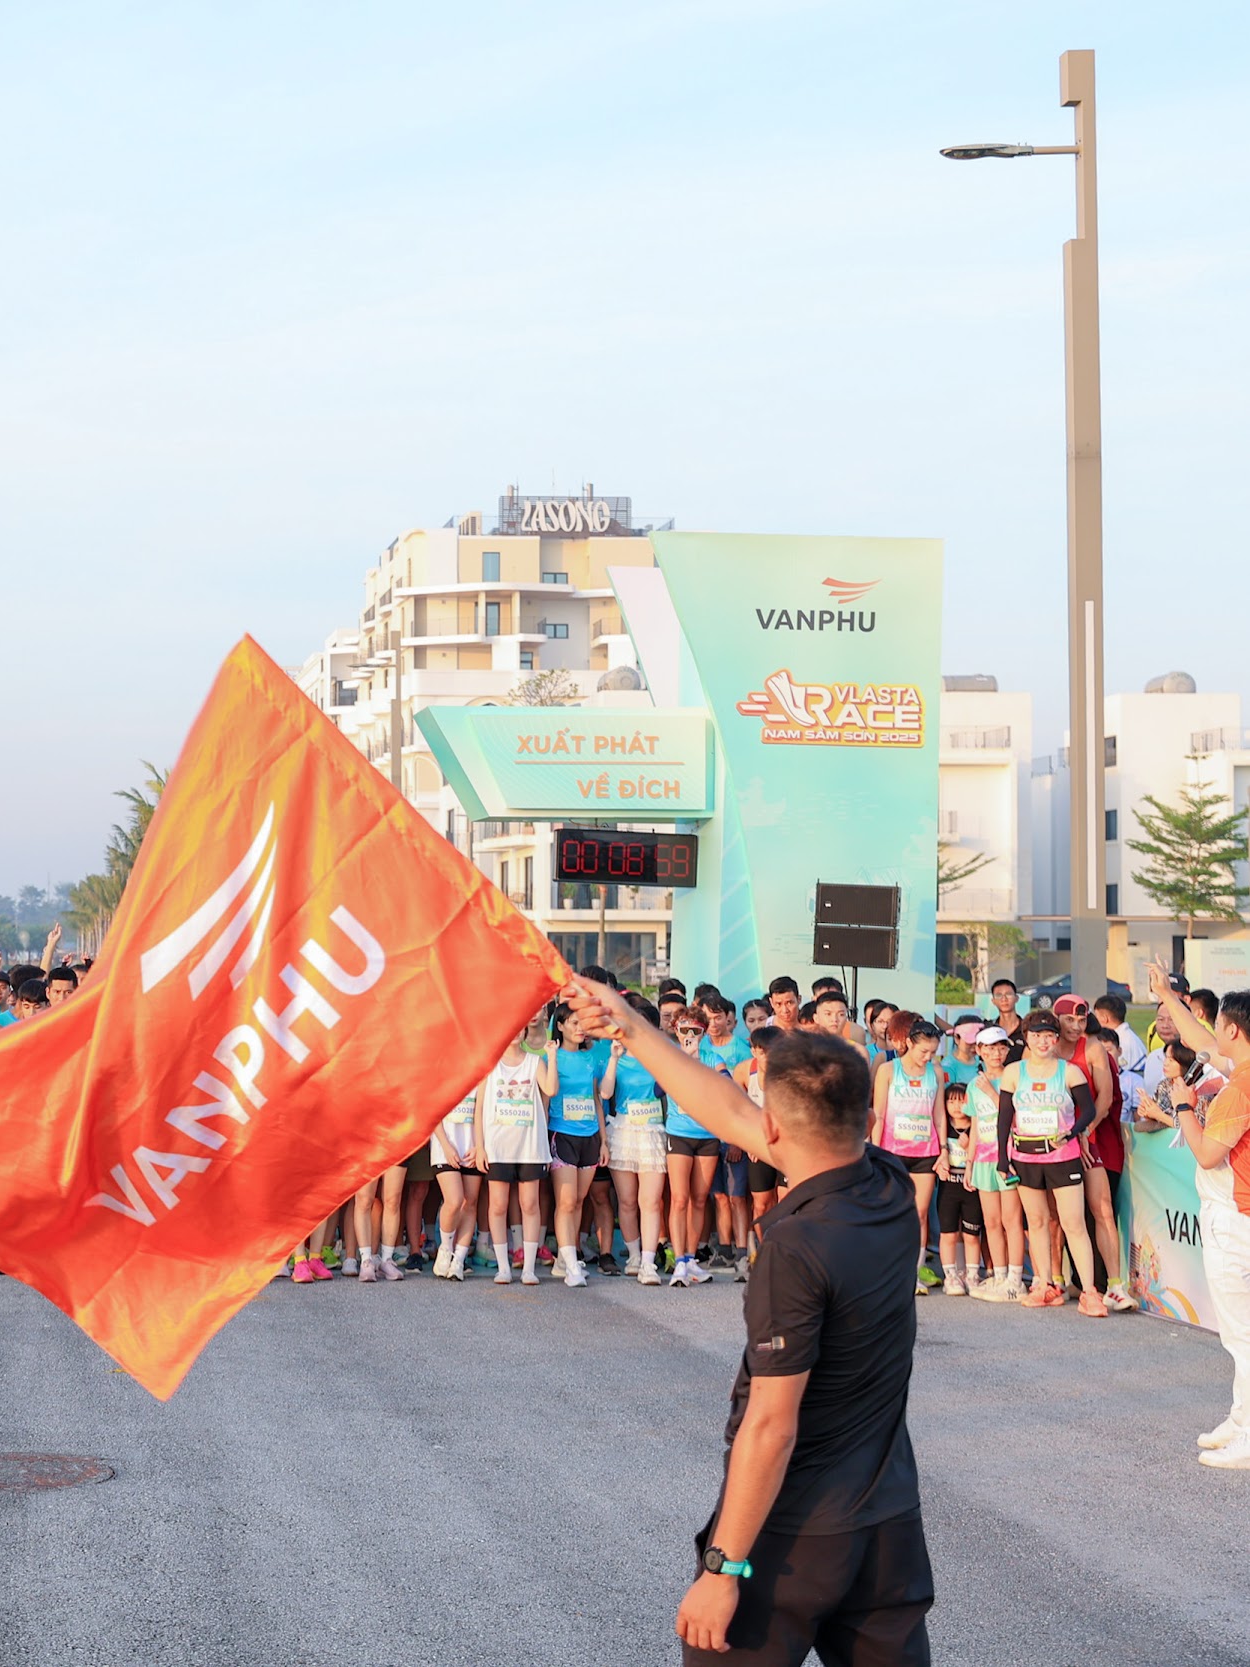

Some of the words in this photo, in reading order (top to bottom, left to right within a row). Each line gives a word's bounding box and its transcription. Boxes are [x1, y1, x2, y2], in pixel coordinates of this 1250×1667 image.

[756, 608, 876, 632] VANPHU
[835, 685, 920, 705] VLASTA
[517, 727, 586, 754] XUẤT
[594, 730, 660, 755] PHÁT
[764, 729, 800, 739] NAM
[880, 733, 919, 743] 2025
[618, 775, 681, 799] ĐÍCH
[83, 905, 386, 1226] VANPHU
[1015, 1090, 1065, 1105] KANHO
[499, 1109, 530, 1117] SS50286
[1165, 1208, 1203, 1248] VAN
